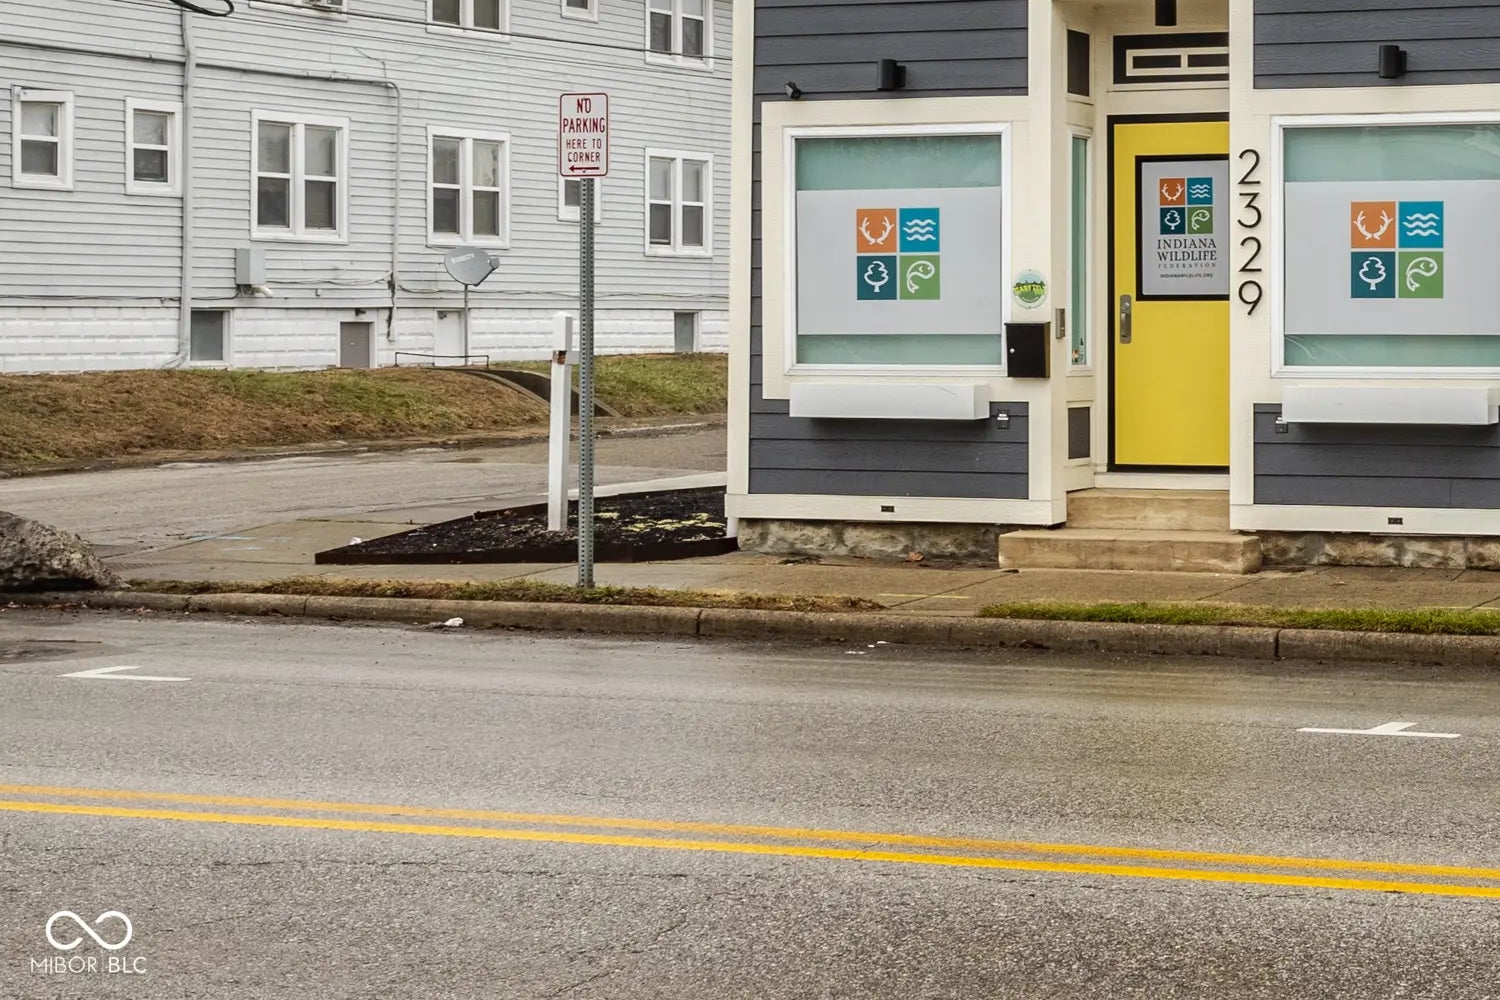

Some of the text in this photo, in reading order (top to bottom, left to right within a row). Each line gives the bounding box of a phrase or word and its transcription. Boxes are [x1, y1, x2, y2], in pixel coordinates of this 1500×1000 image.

[577, 98, 591, 113] NO
[563, 117, 605, 133] PARKING
[566, 138, 602, 149] HERE TO
[567, 151, 600, 162] CORNER
[1237, 148, 1263, 316] 2329
[1157, 238, 1217, 249] INDIANA
[1157, 250, 1217, 261] WILDLIFE
